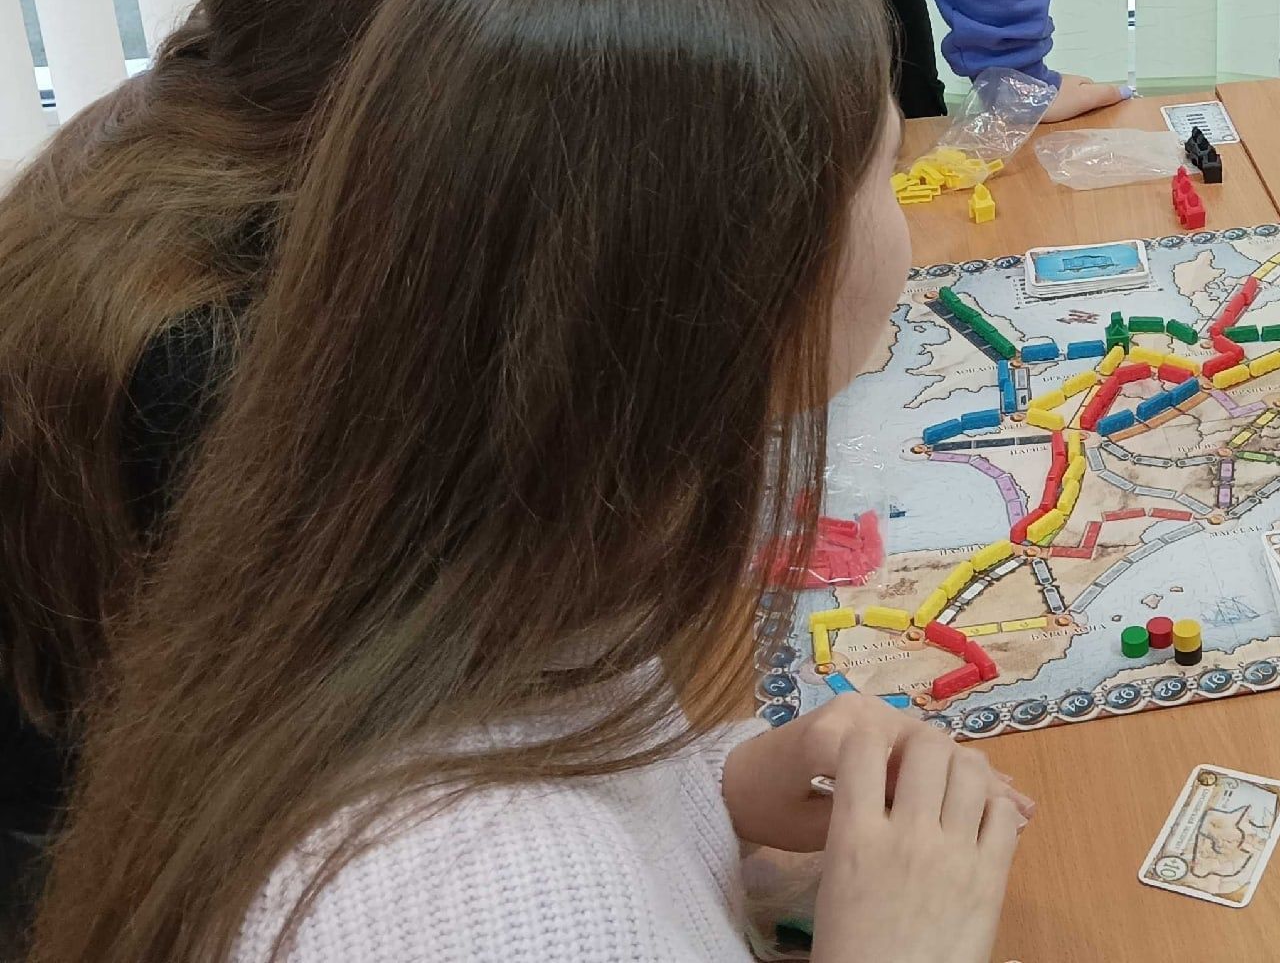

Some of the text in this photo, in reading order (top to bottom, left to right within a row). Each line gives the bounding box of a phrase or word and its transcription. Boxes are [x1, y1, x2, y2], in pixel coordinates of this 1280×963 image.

[969, 712, 994, 729] 96
[1066, 697, 1090, 713] 94
[1111, 688, 1136, 704] 93
[1159, 681, 1183, 698] 92
[1205, 672, 1227, 689] 91
